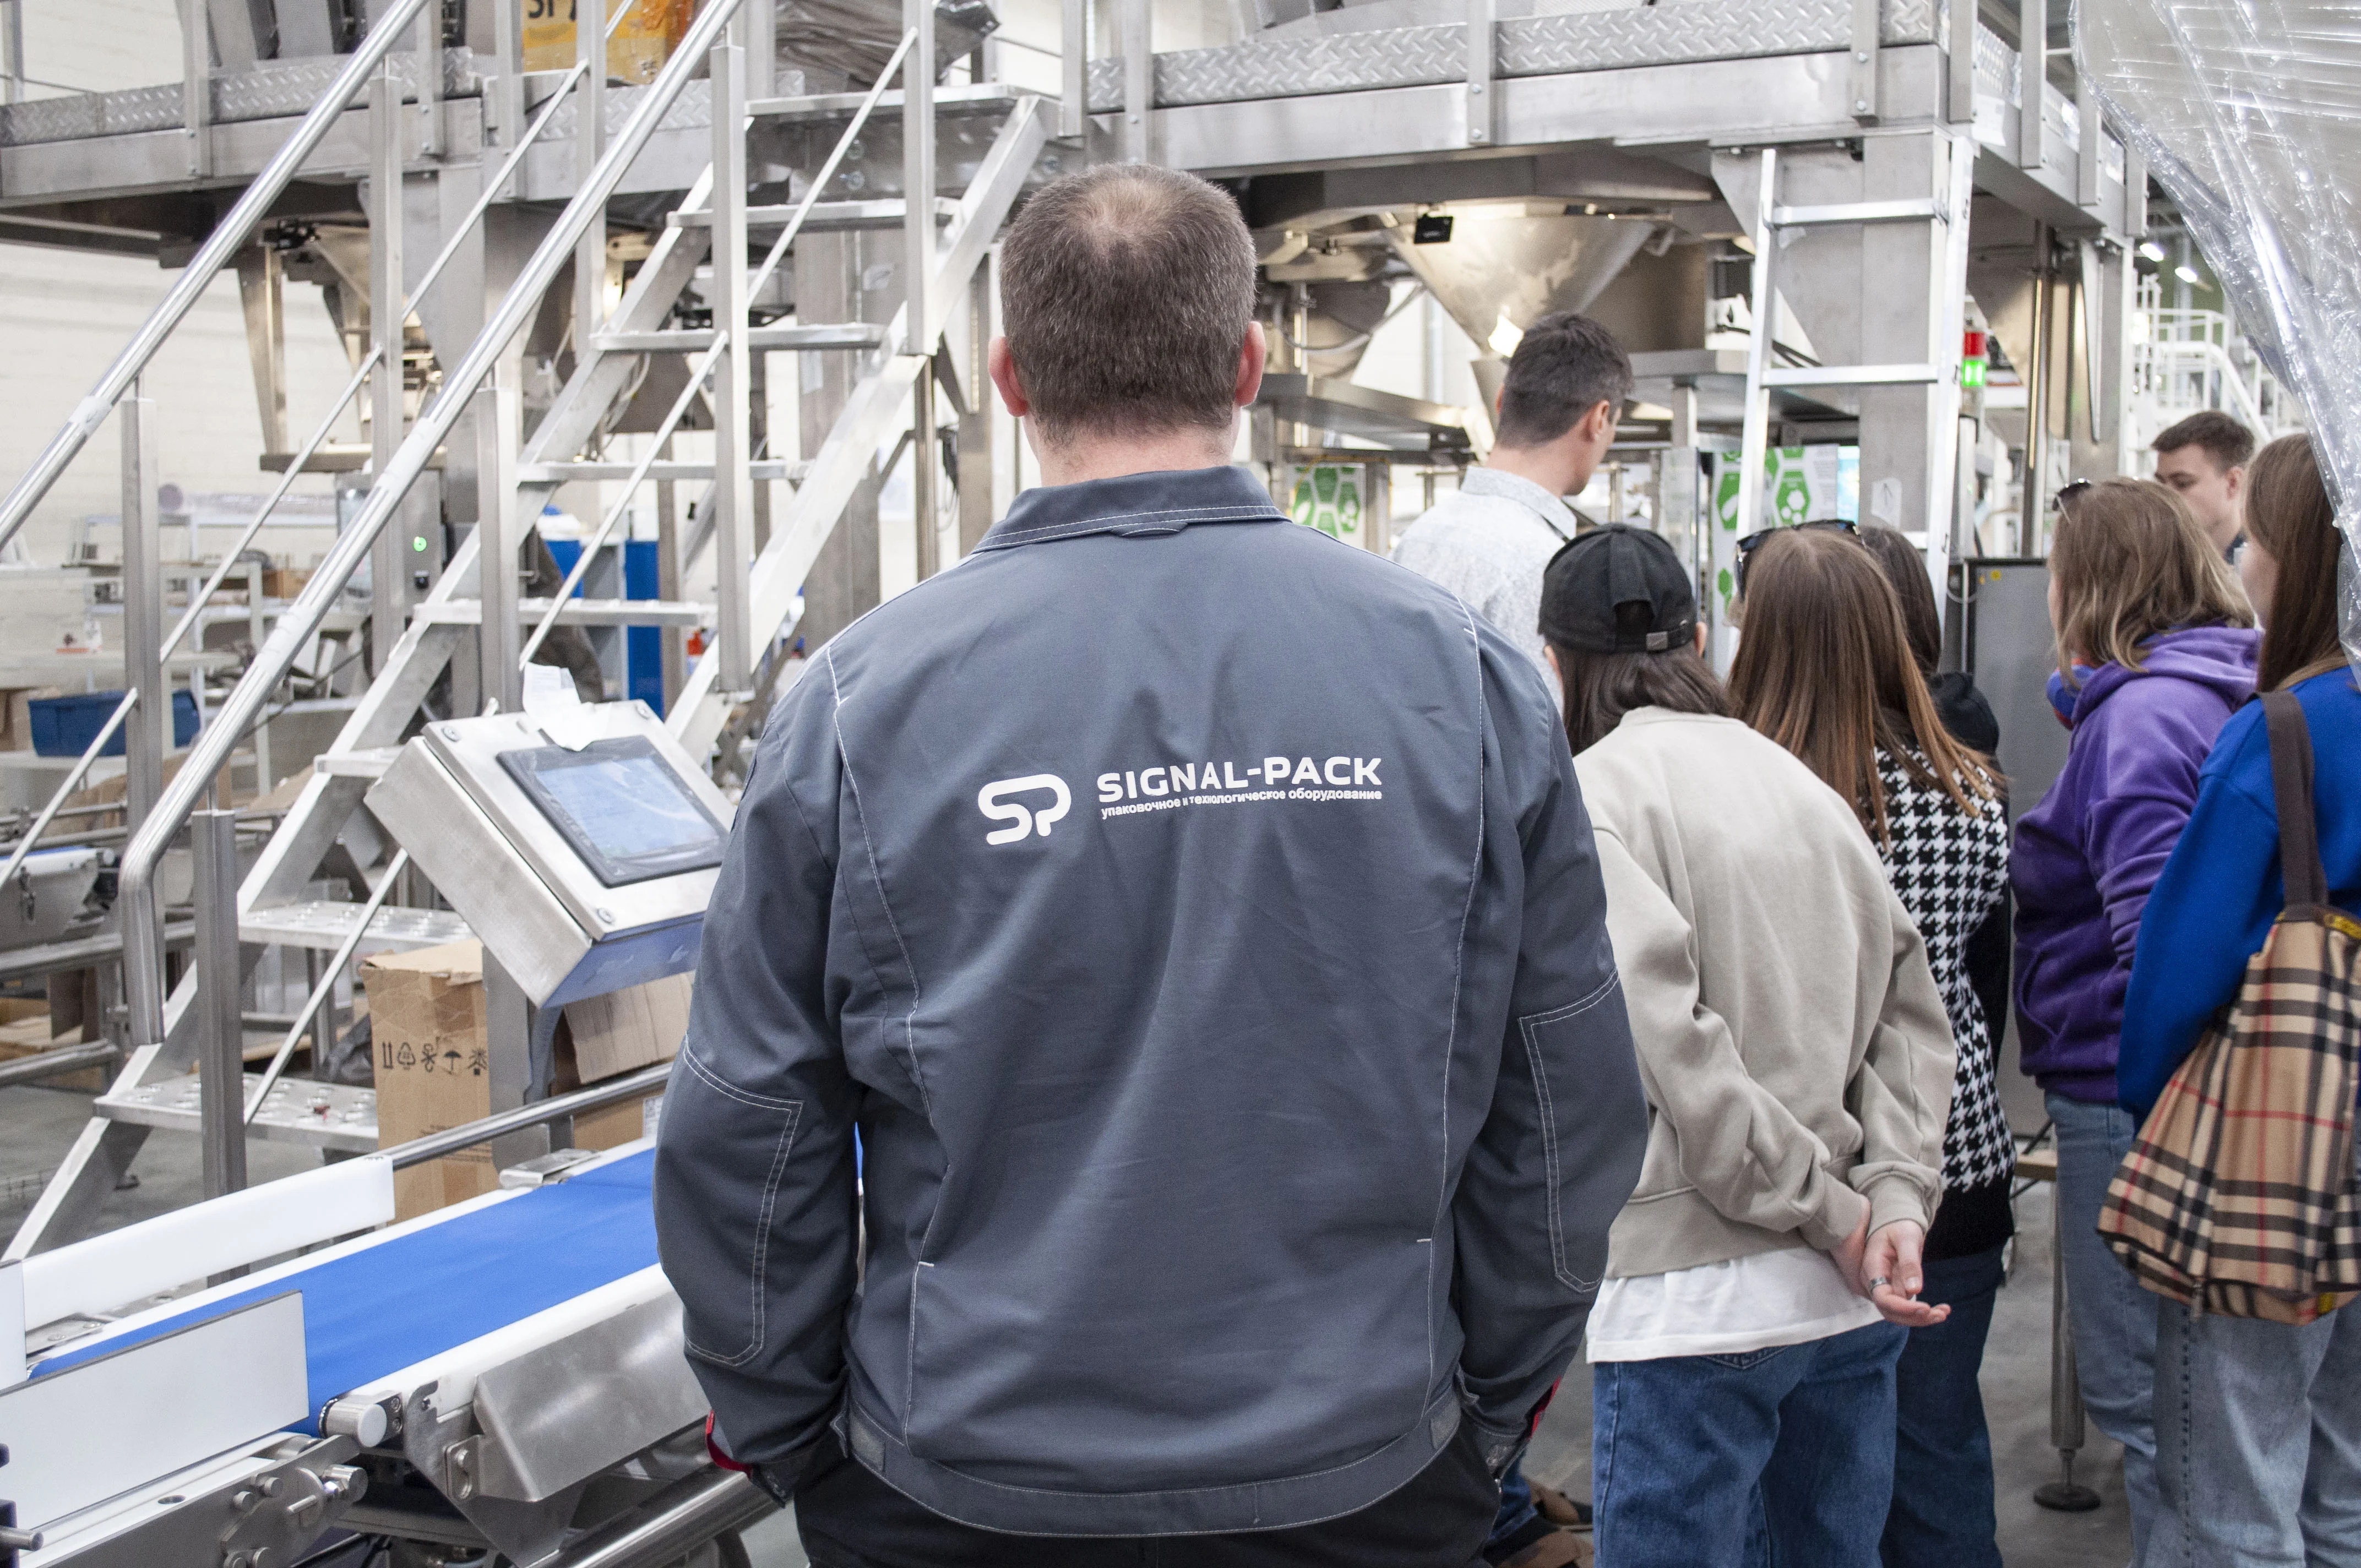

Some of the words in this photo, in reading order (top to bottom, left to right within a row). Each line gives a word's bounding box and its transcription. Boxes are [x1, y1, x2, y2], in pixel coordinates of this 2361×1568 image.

[1097, 756, 1381, 803] SIGNAL-PACK
[978, 774, 1071, 845] SP
[1101, 798, 1181, 820] упаковочное
[1183, 798, 1188, 806] и
[1190, 791, 1286, 804] технологическое
[1288, 787, 1382, 802] оборудование
